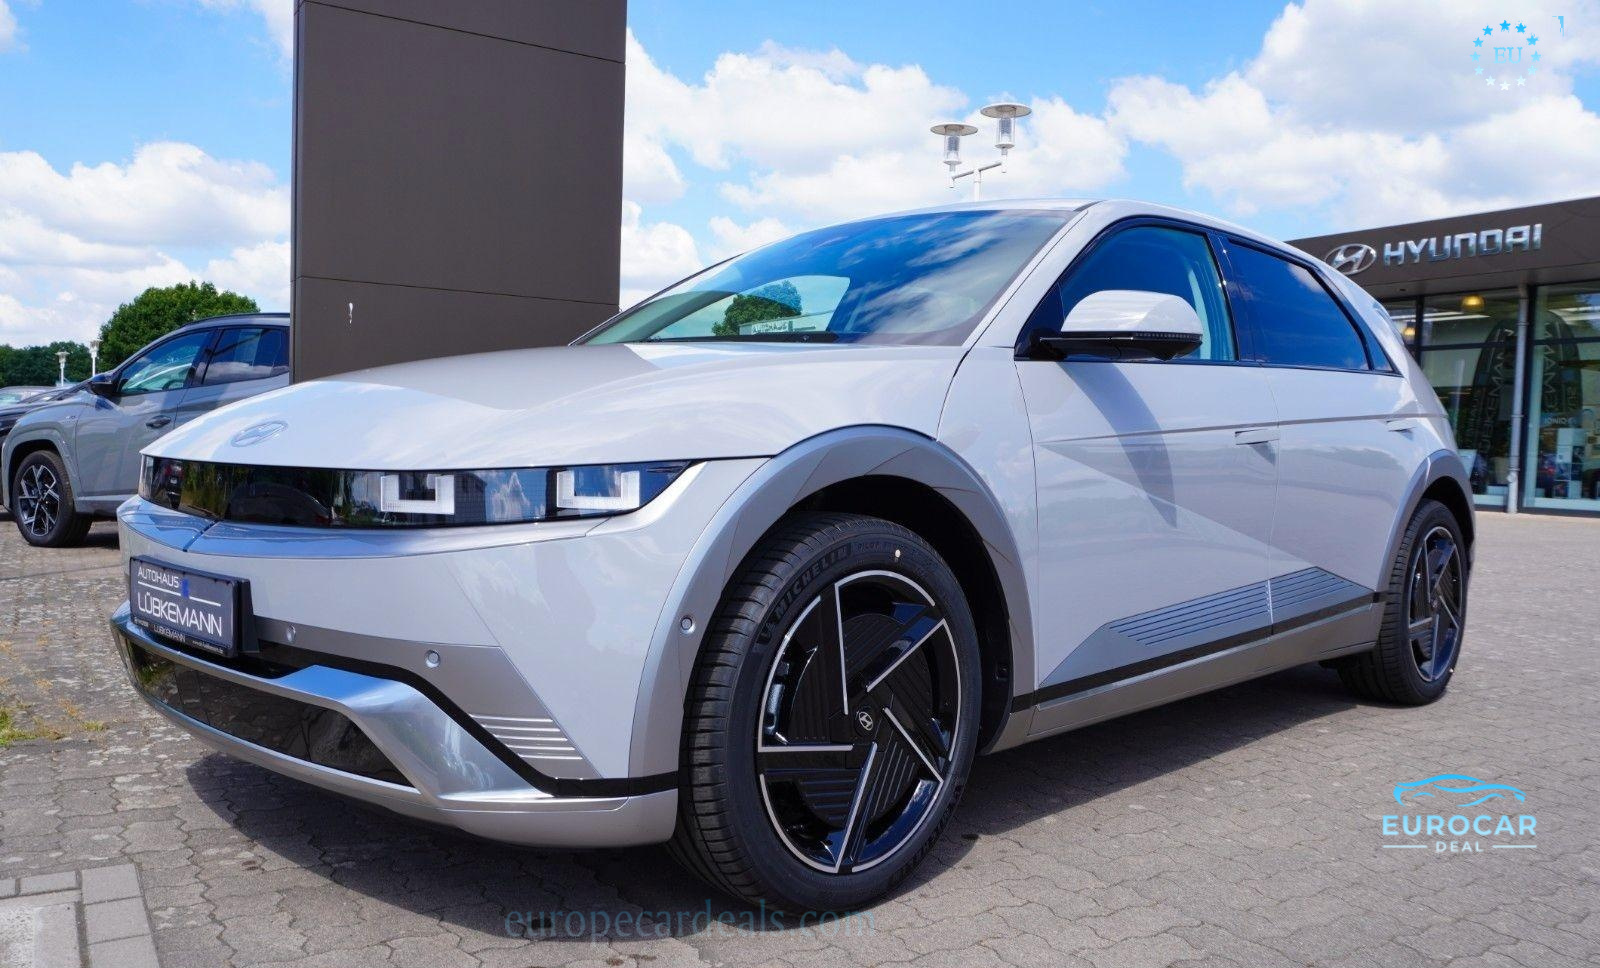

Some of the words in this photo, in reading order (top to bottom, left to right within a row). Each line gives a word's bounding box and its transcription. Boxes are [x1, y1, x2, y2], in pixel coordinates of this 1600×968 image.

[1383, 223, 1543, 266] HYUNDAI
[138, 566, 180, 589] AUTOHAUS
[137, 591, 222, 637] LÜBKEMANN
